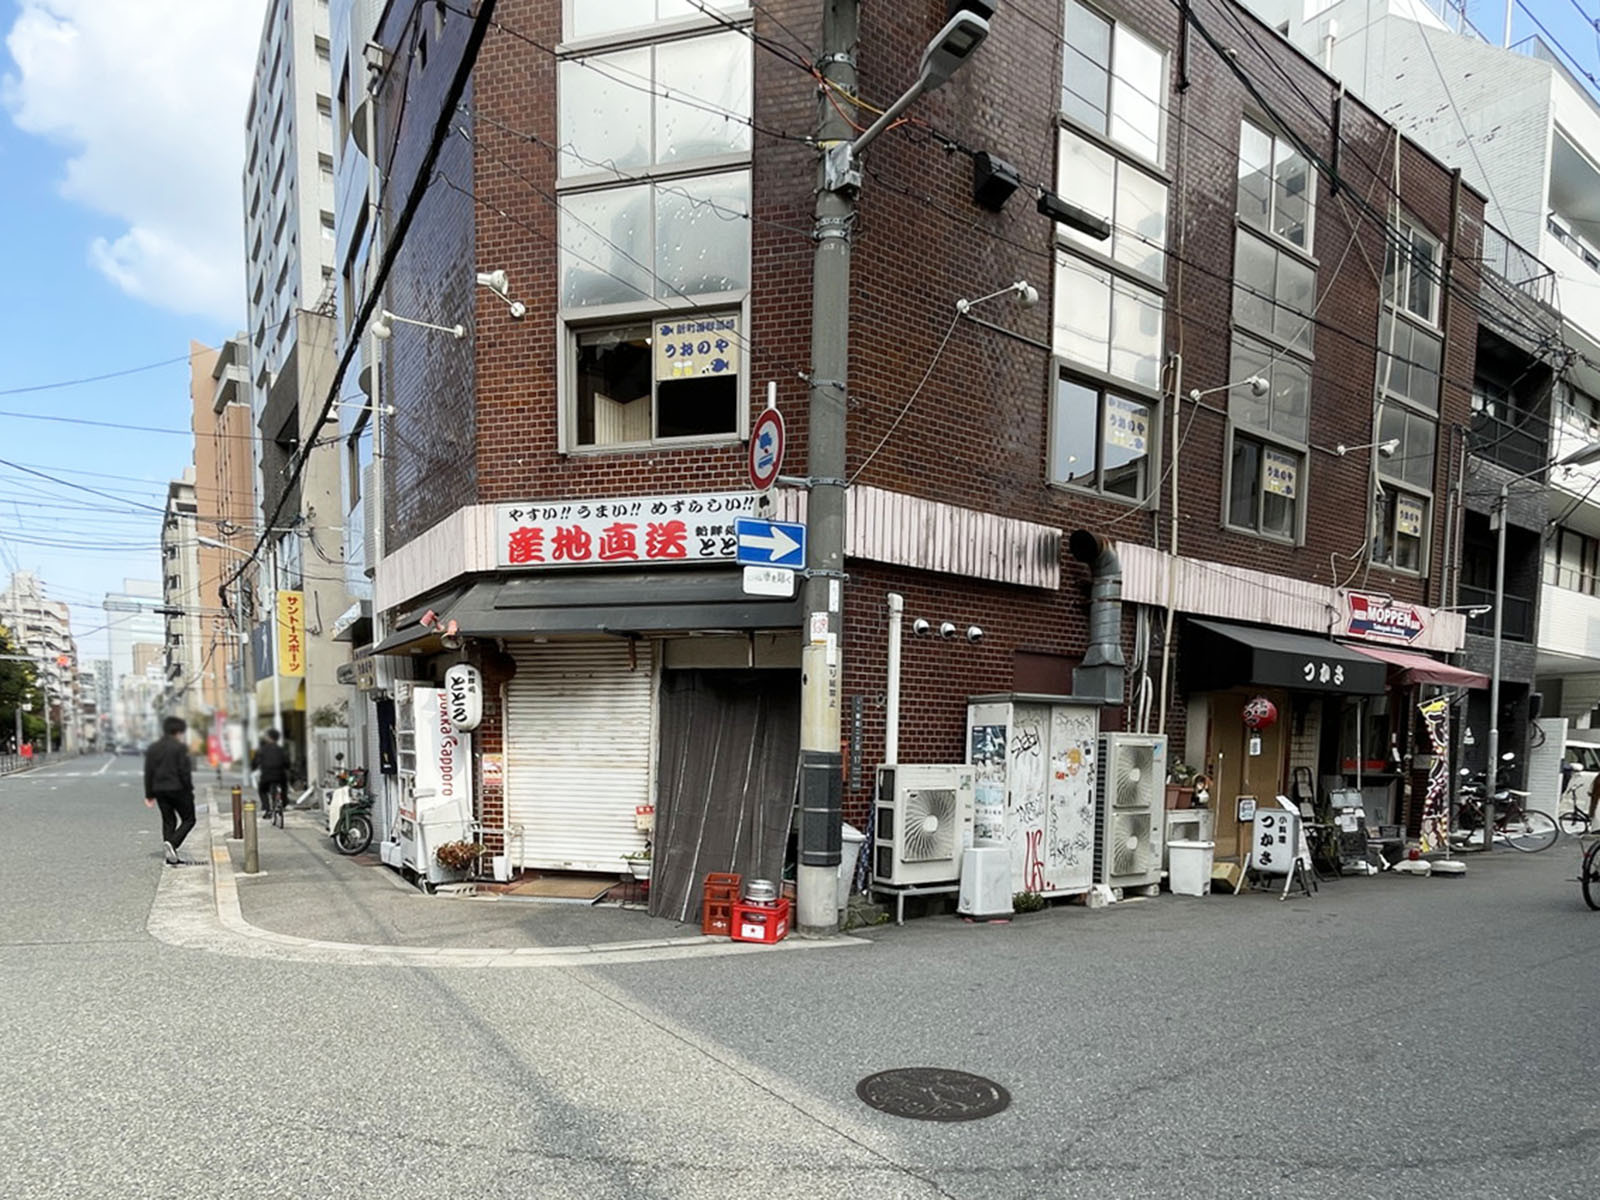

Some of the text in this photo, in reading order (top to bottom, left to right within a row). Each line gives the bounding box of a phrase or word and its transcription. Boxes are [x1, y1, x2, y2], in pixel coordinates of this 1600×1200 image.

[665, 338, 729, 358] うおのや
[509, 506, 572, 522] やすい!!
[577, 502, 642, 519] うまい!!
[699, 537, 737, 557] とと
[1367, 606, 1412, 628] MOPPEN
[286, 596, 300, 673] サントースポーツ
[439, 743, 454, 797] sapporo
[1259, 815, 1275, 866] つかさ
